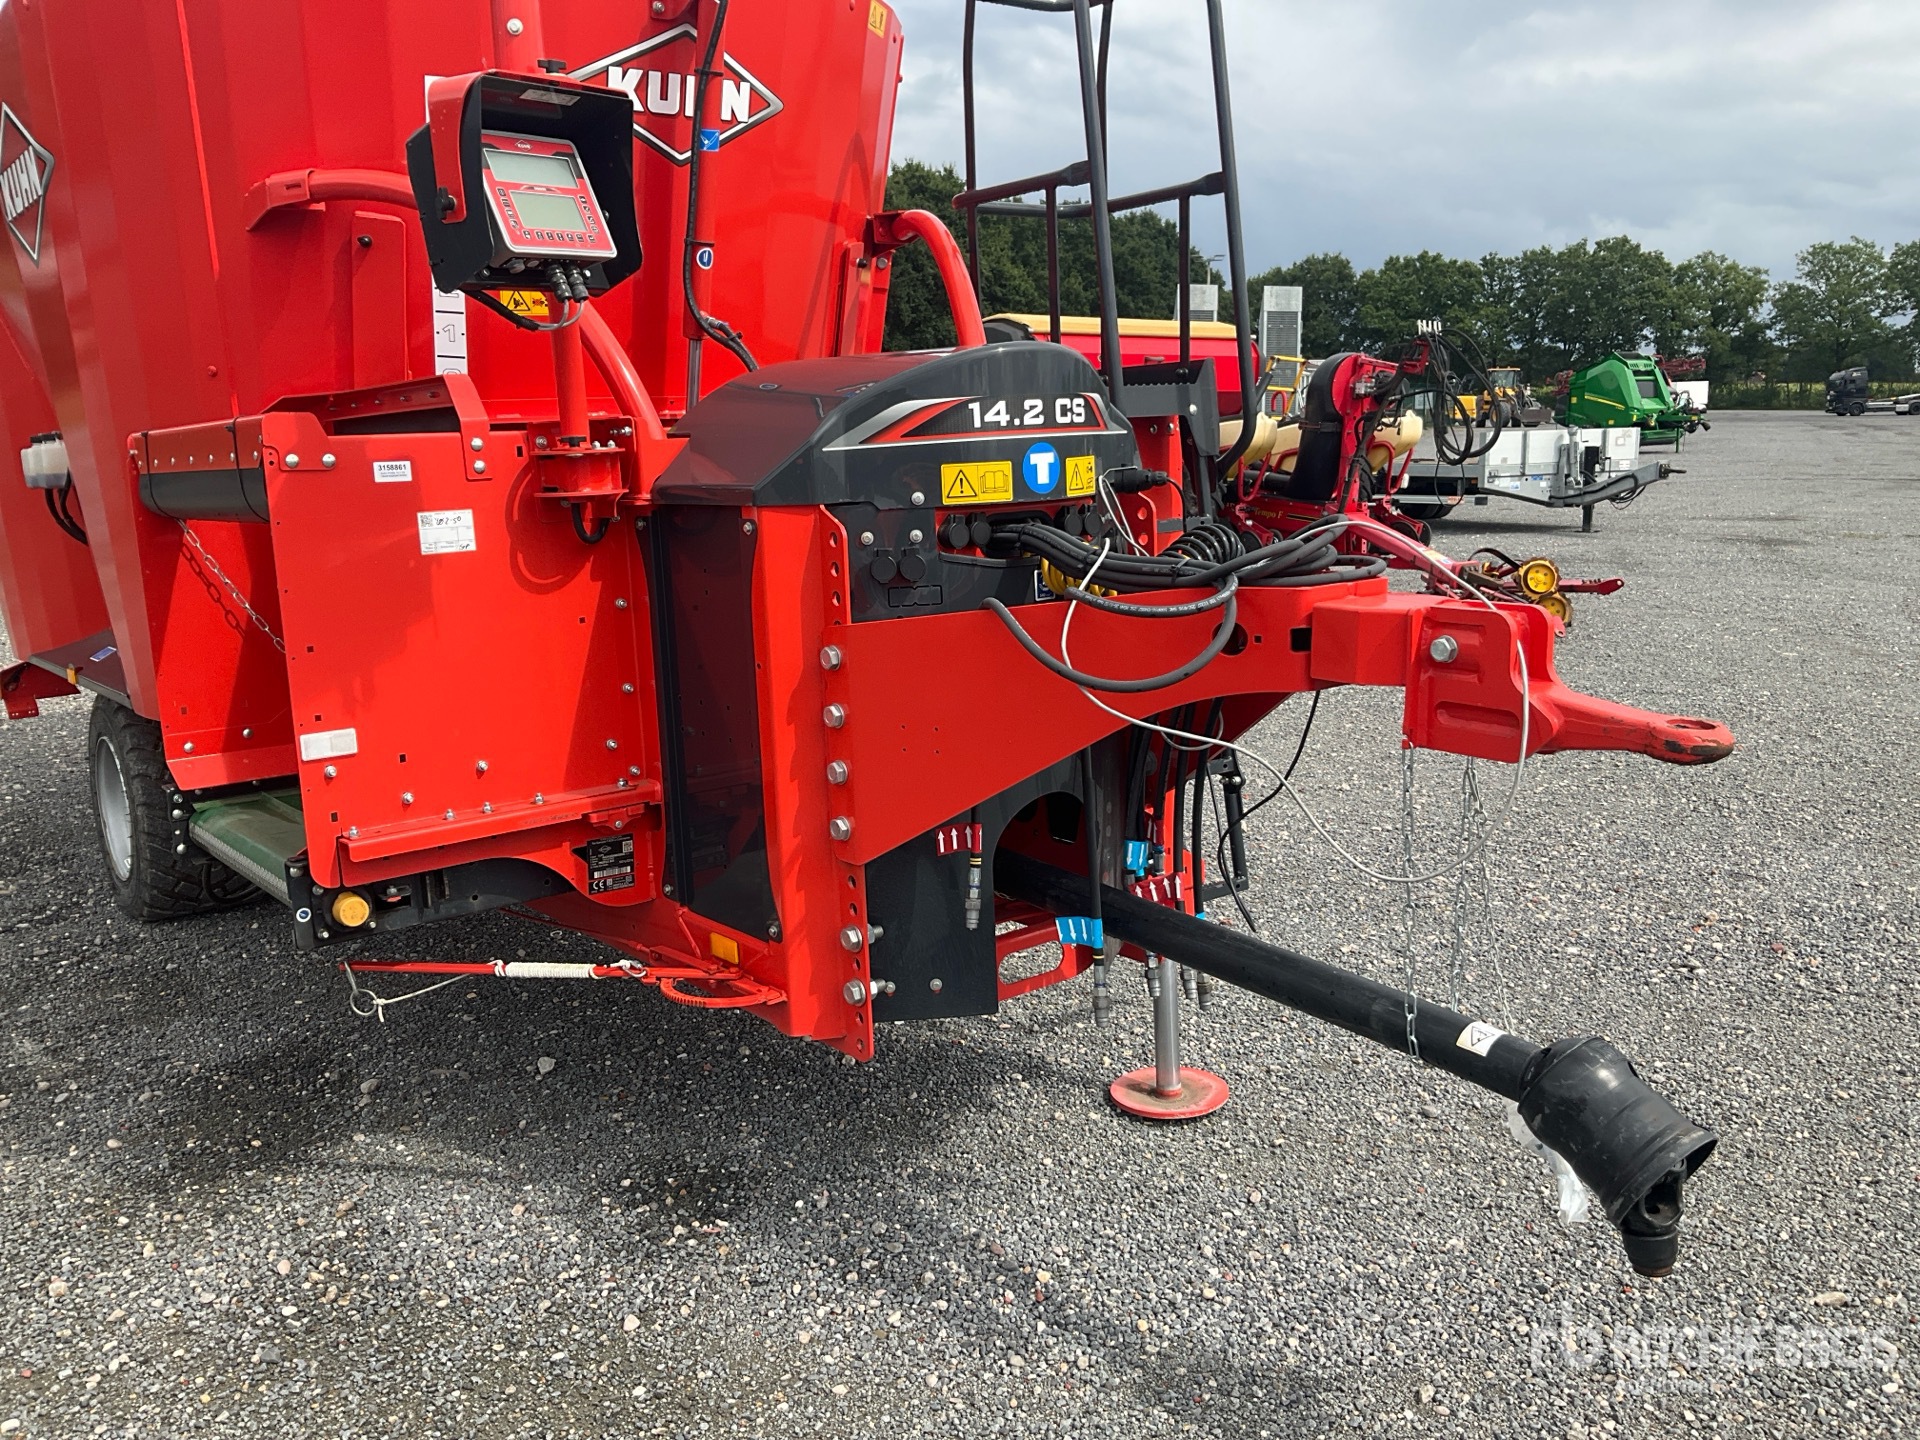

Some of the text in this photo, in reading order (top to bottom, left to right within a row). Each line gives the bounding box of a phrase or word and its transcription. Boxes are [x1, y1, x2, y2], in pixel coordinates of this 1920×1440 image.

[0, 145, 42, 222] KUHN
[442, 323, 456, 343] 1
[968, 397, 1086, 429] 14.2 CS
[377, 464, 407, 472] 3158861
[1029, 451, 1055, 485] T
